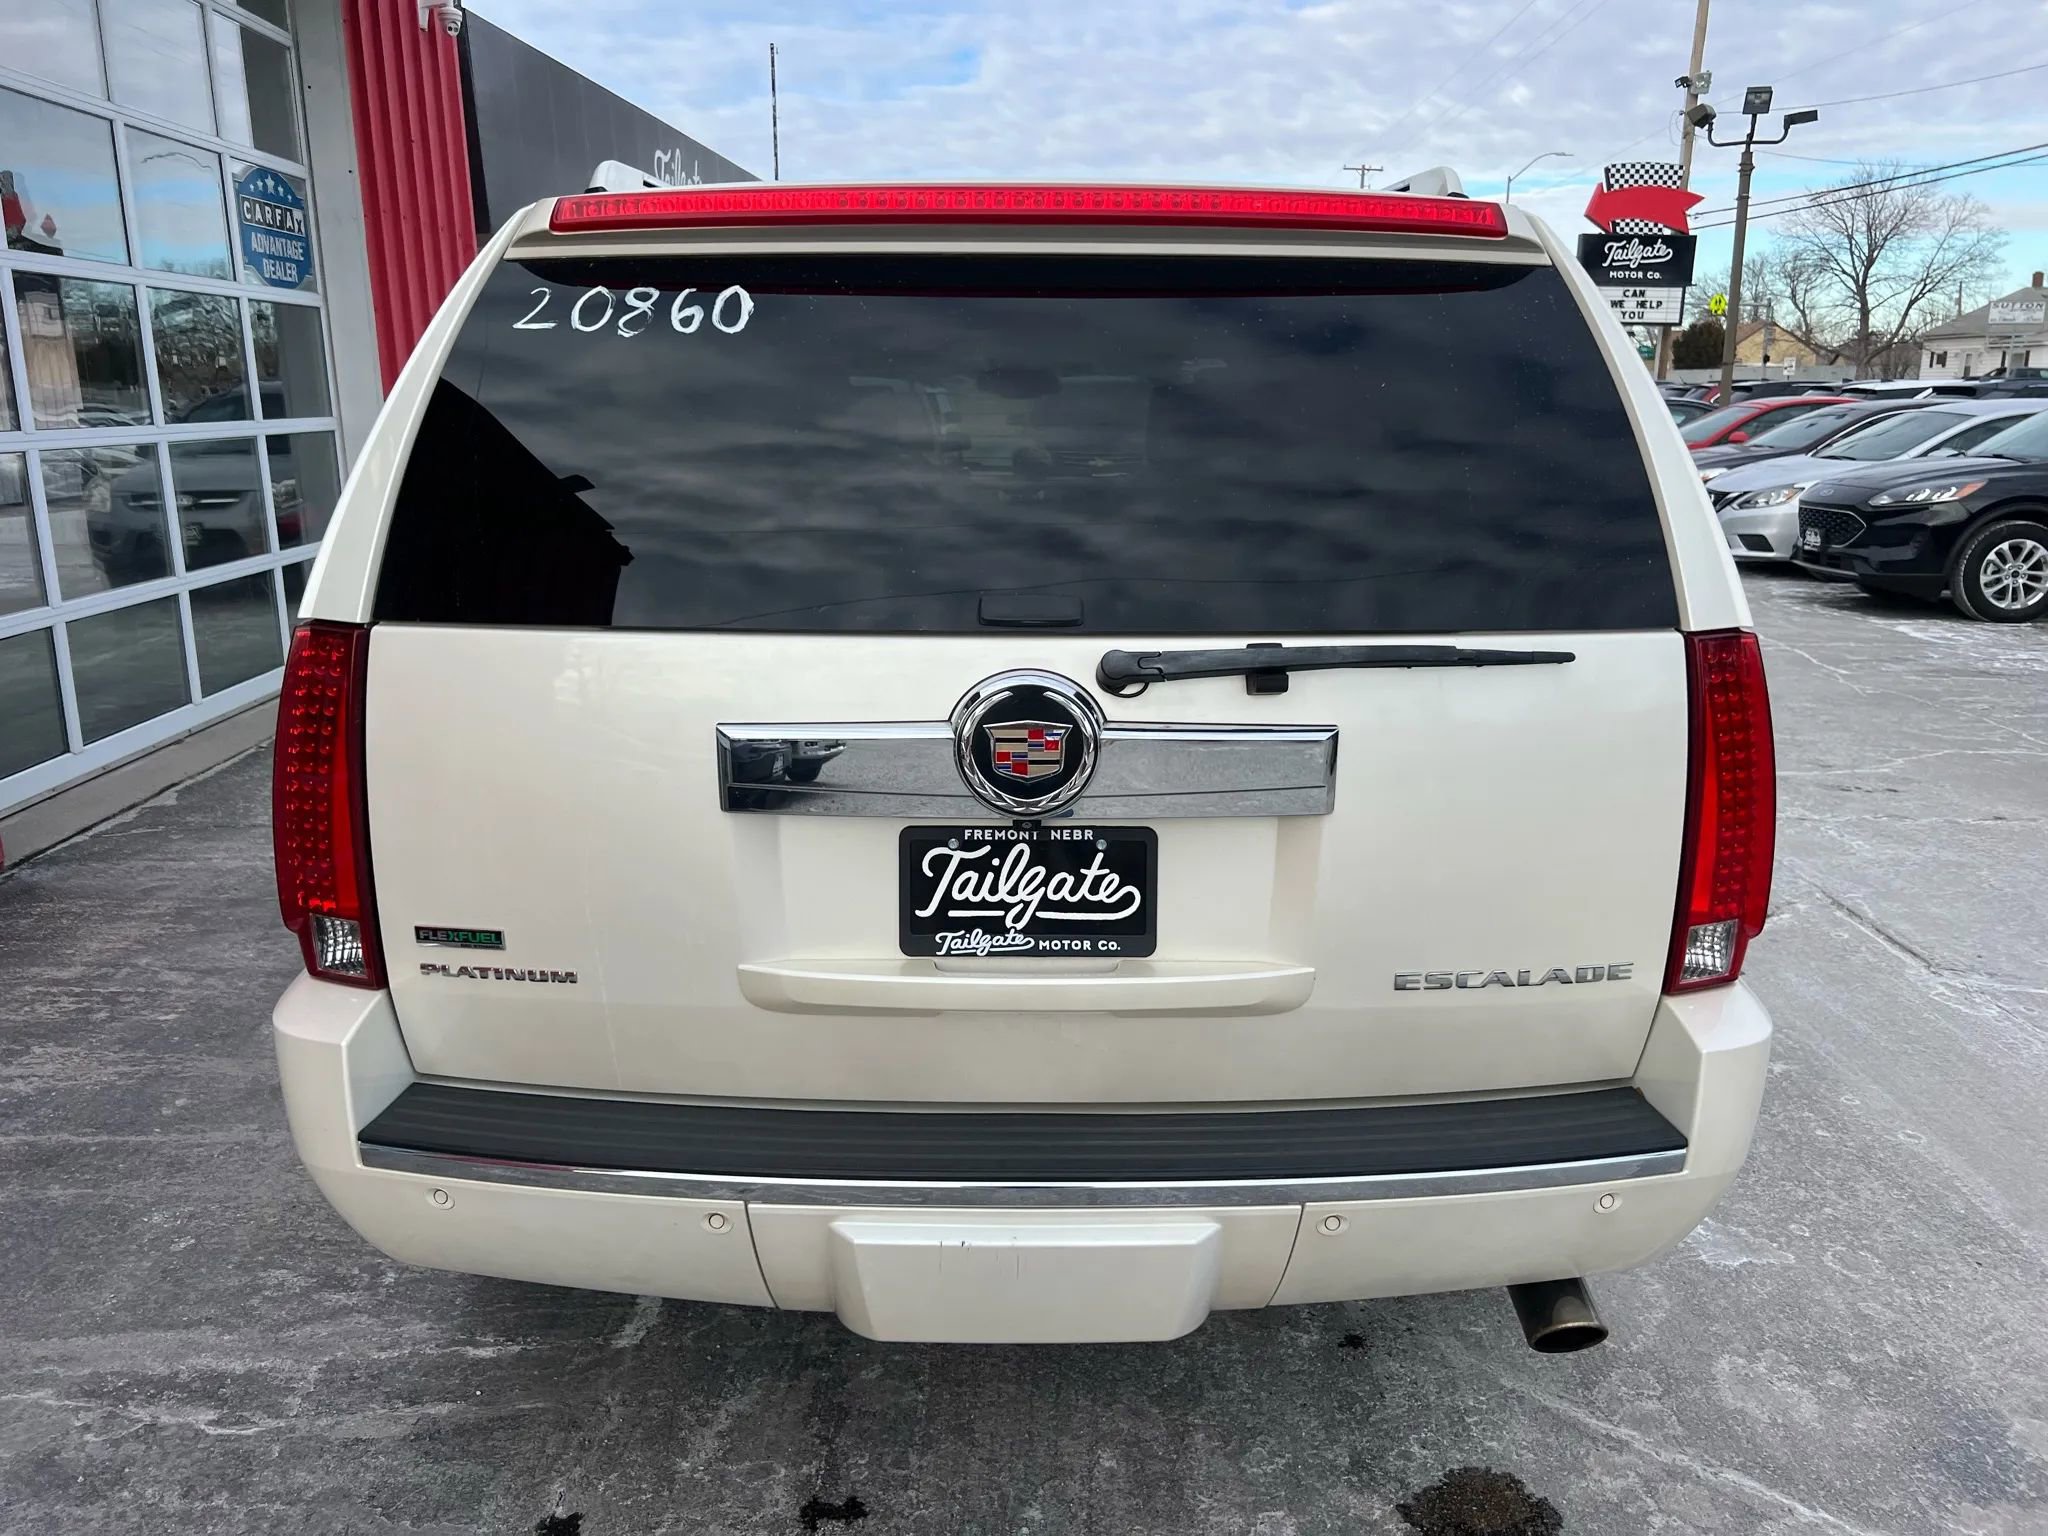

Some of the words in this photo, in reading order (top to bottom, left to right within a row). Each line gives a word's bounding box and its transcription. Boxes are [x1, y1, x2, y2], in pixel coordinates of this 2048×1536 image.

[243, 201, 304, 234] CARFAX
[251, 231, 305, 261] ADVANTAGE
[1602, 238, 1673, 268] Tailgate
[262, 258, 298, 283] DEALER
[1609, 270, 1643, 279] MOTOR
[1610, 300, 1625, 309] WE
[1636, 300, 1663, 309] HELP
[1623, 289, 1646, 298] CAN
[512, 285, 755, 337] 20860
[1621, 311, 1644, 320] YOU
[964, 829, 1039, 840] FREMONT
[1051, 829, 1094, 840] NEBR
[915, 843, 1141, 930] Tailgate
[419, 930, 502, 943] FLEXFUEL
[935, 928, 1035, 956] Tailgate
[1039, 939, 1091, 950] MOTOR
[420, 963, 578, 983] PLATINUM
[1394, 962, 1634, 990] ESCALADE
